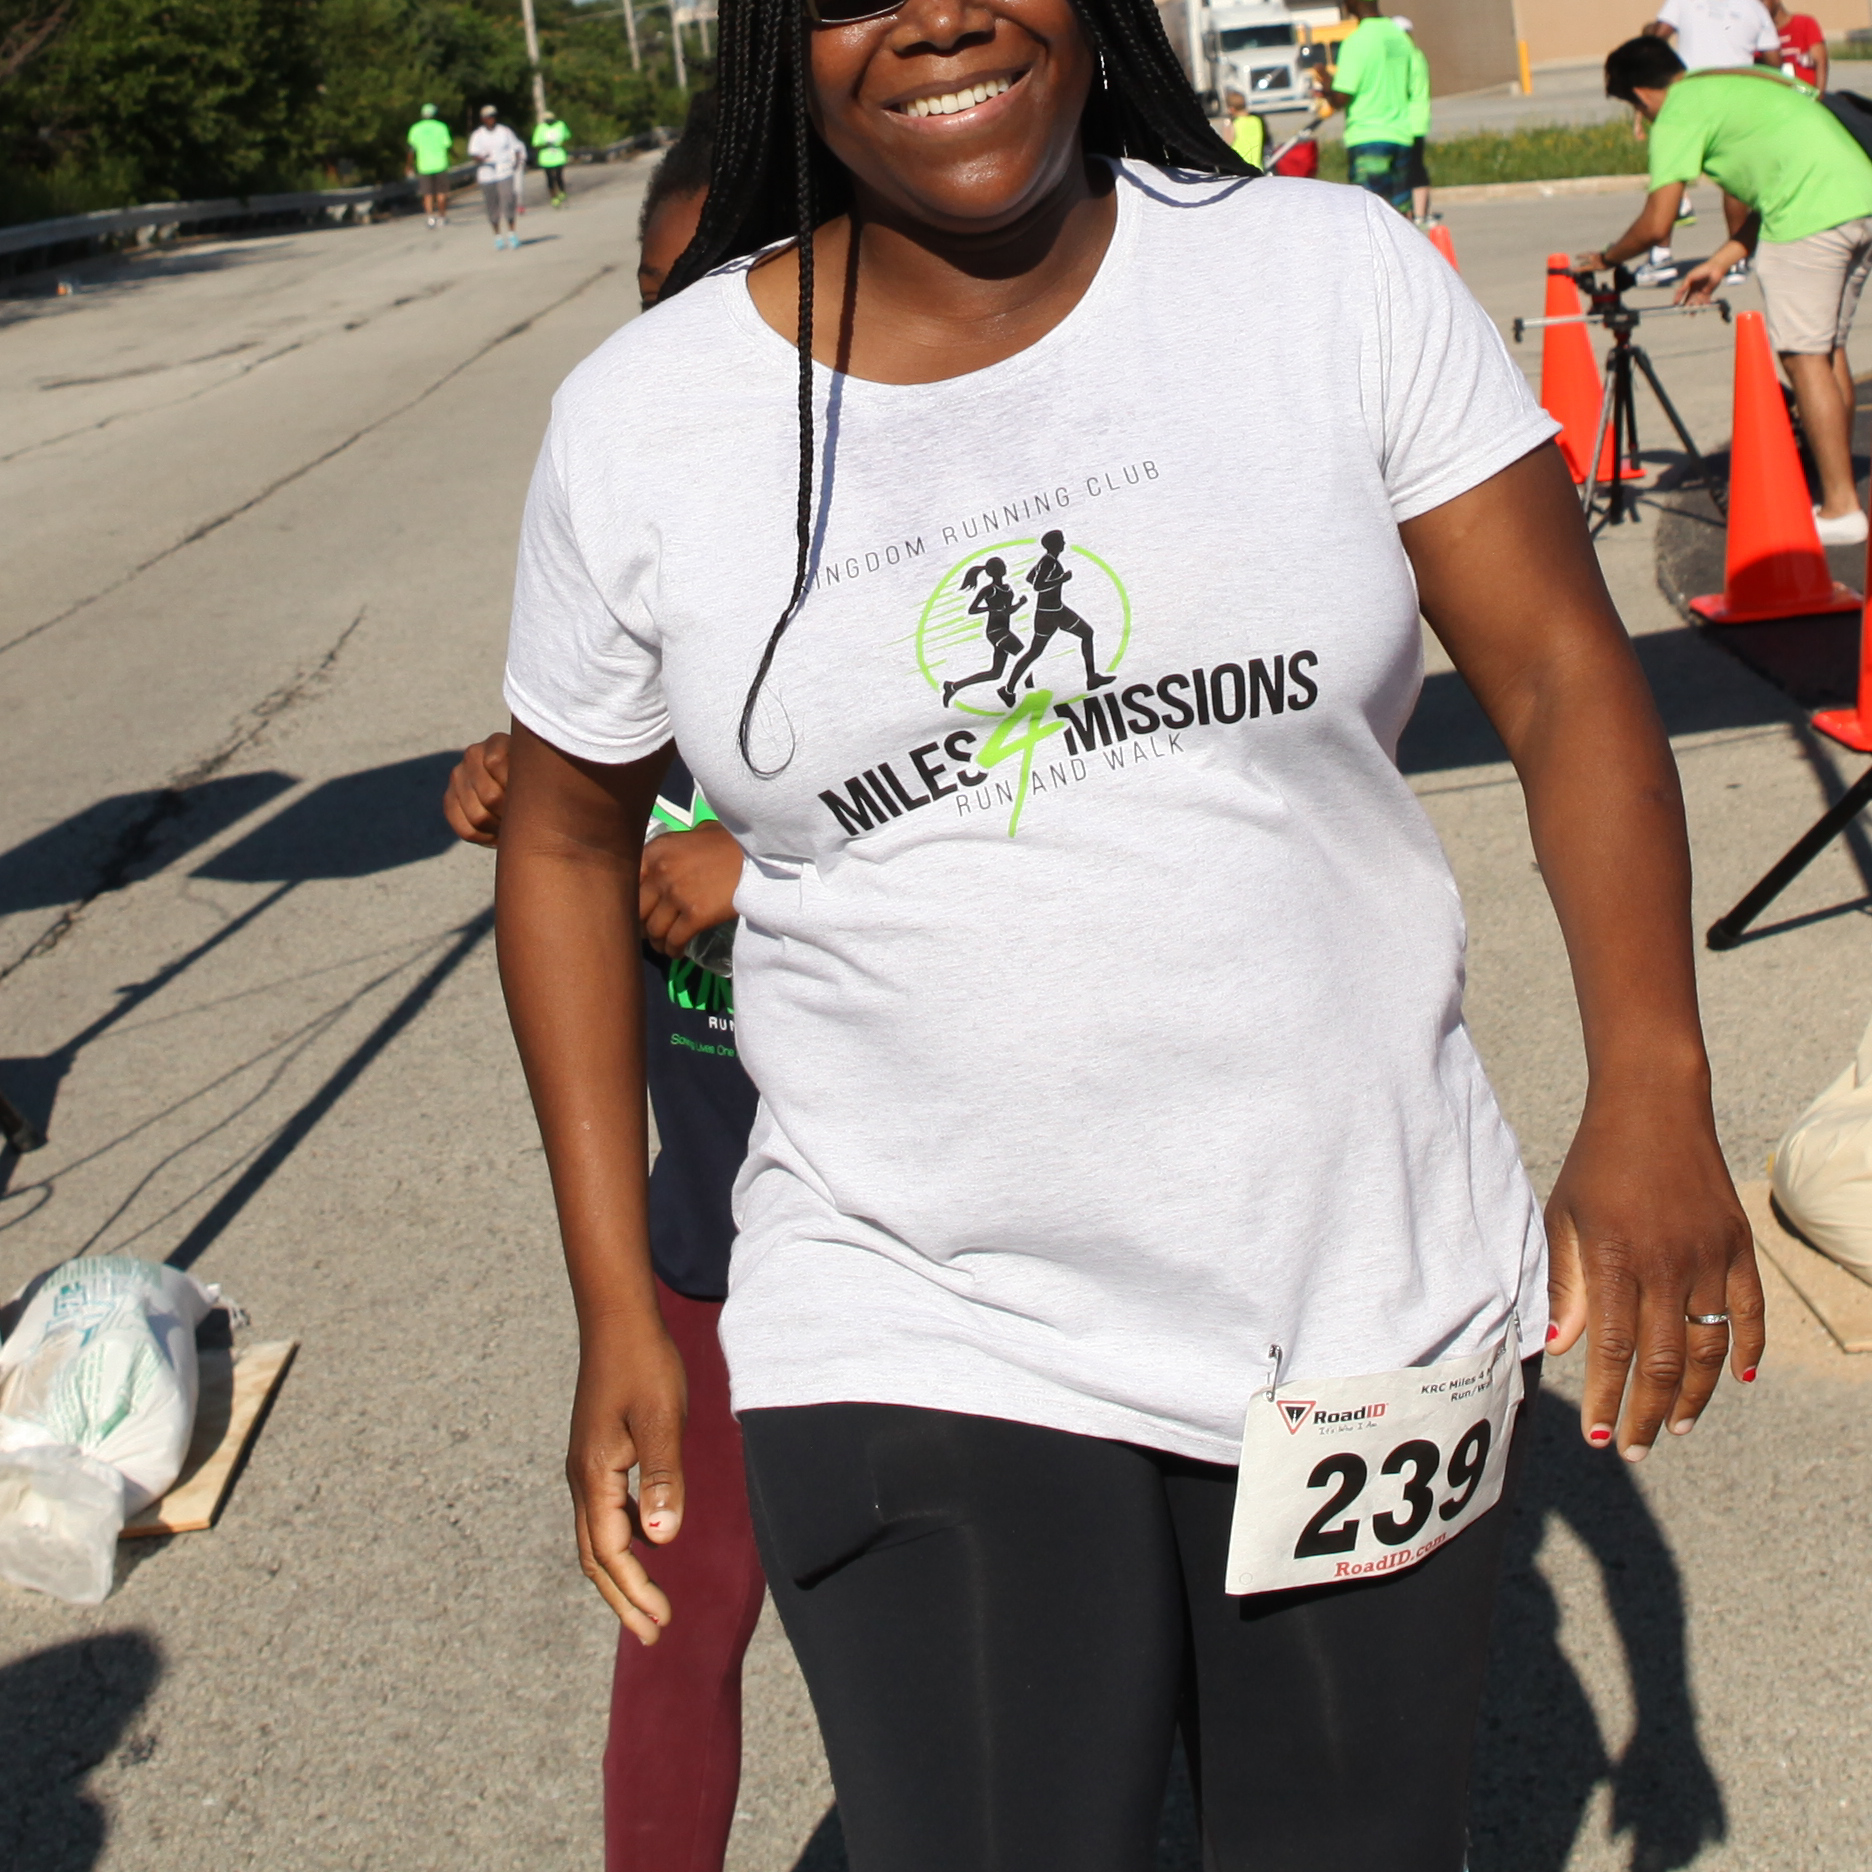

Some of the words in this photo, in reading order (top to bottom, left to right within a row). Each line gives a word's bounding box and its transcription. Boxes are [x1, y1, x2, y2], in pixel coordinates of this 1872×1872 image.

[813, 536, 926, 590] INGDOM
[941, 486, 1071, 546] RUNNING
[1085, 459, 1160, 498] CLUB
[818, 730, 989, 837] MILES
[976, 689, 1065, 839] 4
[1053, 650, 1320, 756] MISSIONS
[955, 779, 1014, 816] RUN
[1030, 757, 1089, 796] AND
[1103, 732, 1186, 772] WALK
[716, 1044, 734, 1057] One
[1313, 1403, 1386, 1425] RoadID
[1421, 1383, 1447, 1395] KRC
[1449, 1376, 1477, 1390] Miles
[1478, 1370, 1484, 1379] 4
[1294, 1419, 1492, 1560] 239
[1333, 1531, 1448, 1578] RoadID.com
